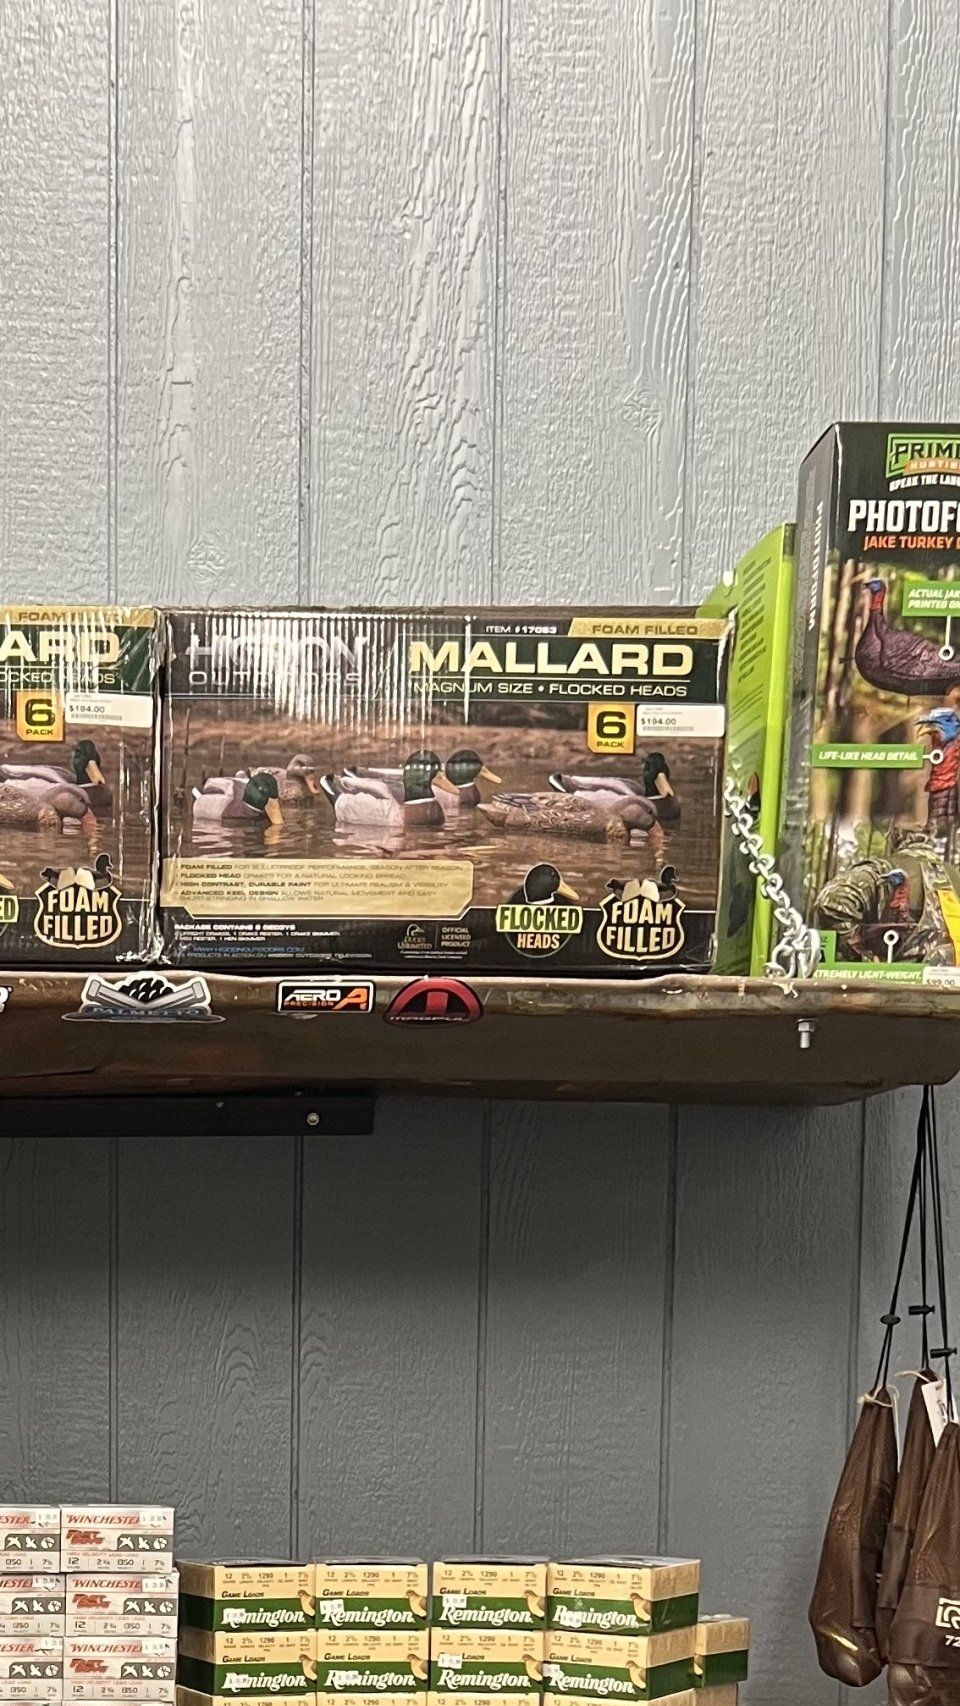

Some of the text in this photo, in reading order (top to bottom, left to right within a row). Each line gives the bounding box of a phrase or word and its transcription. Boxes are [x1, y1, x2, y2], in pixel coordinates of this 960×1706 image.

[891, 441, 960, 466] PRIM
[921, 475, 938, 486] THE
[847, 499, 960, 533] PHOTOF
[864, 535, 953, 551] JAKE TURKEY
[908, 589, 943, 598] ACTUAL
[907, 599, 947, 609] PRINTED
[486, 625, 511, 633] ITEM
[593, 625, 698, 635] FOAM FILLED
[409, 641, 694, 676] MALLARD
[413, 682, 688, 697] MAGNUM SIZE FLOCKED HEADS
[24, 697, 56, 728] 6
[640, 717, 677, 726] $194.00
[25, 728, 54, 737] PACK
[595, 711, 627, 739] 6
[596, 740, 625, 748] PACK
[818, 751, 918, 761] LIFE-LIKE HEAD DETAIL
[47, 890, 110, 914] FOAM
[499, 906, 581, 932] FLOCKED
[611, 900, 673, 925] FOAM
[43, 914, 113, 940] FILLED
[517, 933, 560, 950] HEADS
[606, 925, 676, 951] FILLED
[813, 970, 855, 979] XTREMELY
[285, 989, 343, 1001] AERO
[323, 1607, 414, 1627] Remington
[439, 1605, 533, 1625] Remington
[438, 1670, 531, 1690] Remington
[550, 1671, 635, 1695] Remington
